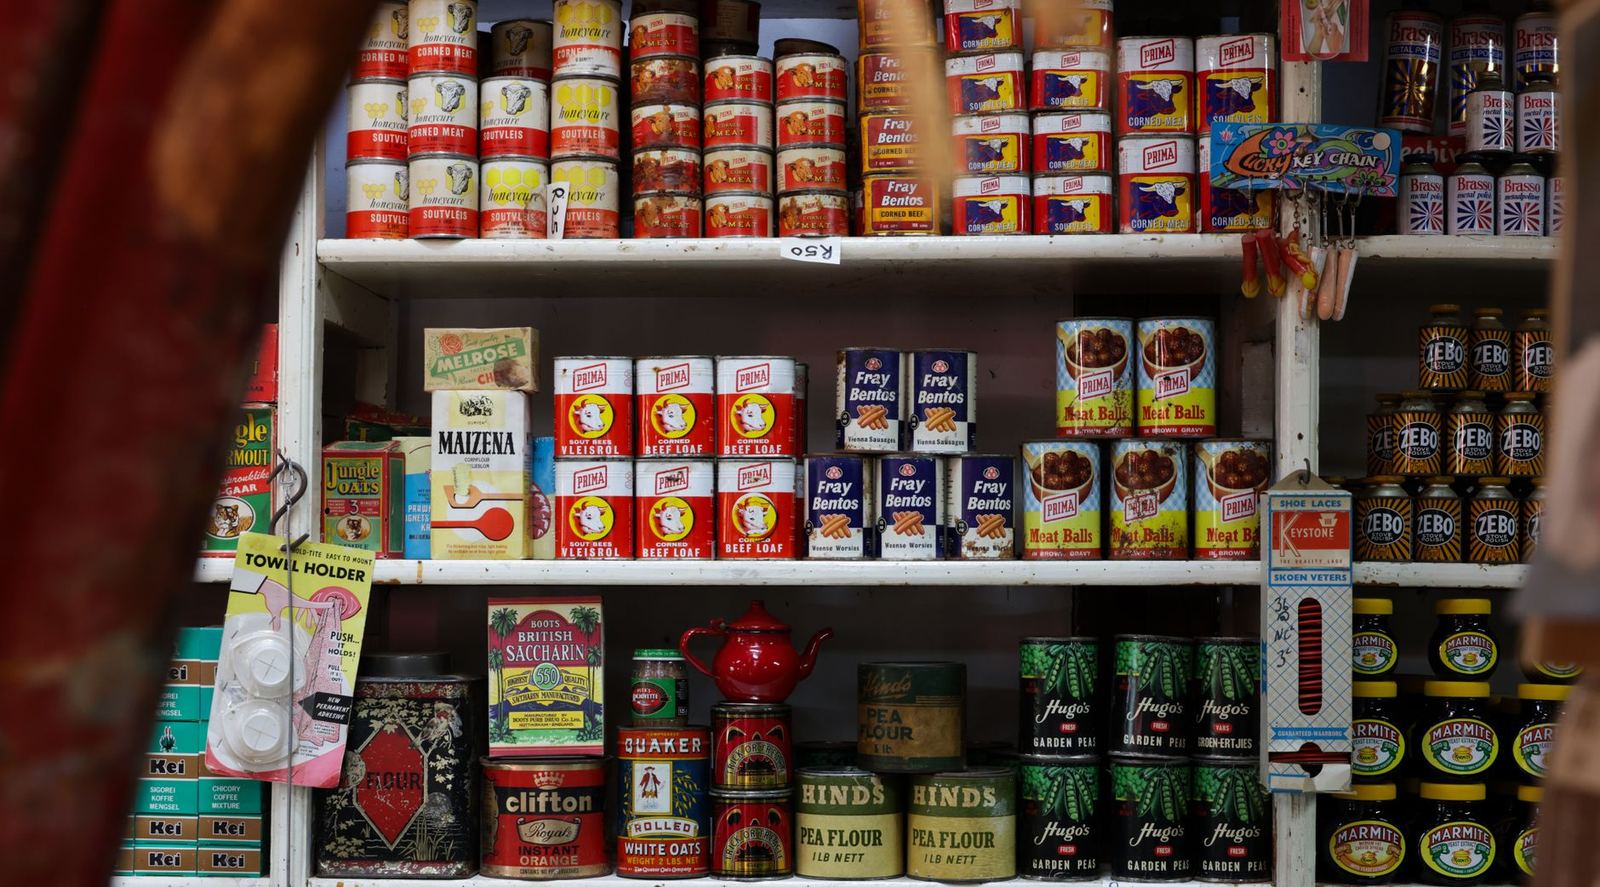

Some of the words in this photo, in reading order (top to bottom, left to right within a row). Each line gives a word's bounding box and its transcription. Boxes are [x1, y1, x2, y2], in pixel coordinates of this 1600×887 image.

[424, 32, 465, 44] honeycure
[560, 25, 611, 39] honeycure
[1451, 29, 1504, 47] Brasso
[418, 46, 450, 57] CORNED
[454, 47, 472, 59] MEAT
[1144, 45, 1172, 63] PRIMA
[983, 119, 999, 129] PRIMA
[410, 128, 438, 139] CORNED
[442, 127, 464, 138] MEAT
[483, 130, 523, 140] SOUTVLEIS
[1293, 151, 1323, 168] KEY
[1329, 152, 1378, 169] CHAIN
[983, 180, 999, 191] PRIMA
[1066, 179, 1081, 190] PRIMA
[1504, 179, 1541, 193] Brasso
[488, 189, 539, 202] honeycure
[423, 209, 467, 220] SOUTVLEIS
[791, 244, 832, 260] R50
[436, 342, 520, 374] MELROSE
[1426, 341, 1464, 363] ZEBO
[1474, 344, 1508, 366] ZEBO
[577, 370, 604, 387] PRIMA
[659, 369, 687, 387] PRIMA
[739, 369, 767, 387] PRIMA
[855, 371, 891, 388] Fray
[923, 374, 958, 390] Fray
[1082, 376, 1110, 394] PRIMA
[850, 388, 896, 401] Bentos
[918, 391, 964, 404] Bentos
[1098, 406, 1127, 421] Balls
[1142, 405, 1171, 421] Meat
[1174, 404, 1205, 420] Balls
[438, 431, 515, 455] MAIZENA
[869, 436, 896, 444] Sausages
[1400, 428, 1438, 451] ZEBO
[1503, 429, 1540, 452] ZEBO
[561, 445, 619, 455] VLEISROL
[645, 445, 673, 454] BEEF
[676, 444, 703, 454] LOAF
[724, 445, 751, 454] BEEF
[754, 445, 782, 454] LOAF
[326, 461, 380, 493] Jungle
[577, 473, 605, 490] PRIMA
[337, 480, 380, 497] OATS
[817, 481, 852, 496] Fray
[890, 477, 925, 493] Fray
[974, 481, 1007, 496] Fray
[349, 500, 359, 516] 3
[812, 497, 858, 510] Bentos
[885, 494, 931, 507] Bentos
[967, 497, 1011, 510] Bentos
[1047, 498, 1075, 517] PRIMA
[1280, 500, 1306, 508] SHOE
[1311, 500, 1342, 508] LACES
[1367, 513, 1402, 535] ZEBO
[1417, 515, 1451, 536] ZEBO
[1478, 514, 1515, 536] ZEBO
[1030, 528, 1058, 544] Meat
[1063, 528, 1093, 543] Balls
[1207, 528, 1238, 543] Meat
[561, 547, 620, 557] VLEISROL
[642, 548, 670, 557] BEEF
[673, 547, 700, 557] LOAF
[725, 543, 753, 552] BEEF
[756, 543, 783, 552] LOAF
[326, 552, 340, 562] EASY
[343, 555, 351, 563] TO
[352, 556, 373, 568] MOUNT
[303, 561, 367, 583] HOLDER
[1274, 573, 1308, 582] SKOEN
[1310, 573, 1347, 582] VETERS
[531, 620, 560, 629] BOOTS
[518, 631, 573, 643] BRITISH
[1447, 635, 1492, 650] MARMITE
[328, 648, 356, 658] HOLDS!
[505, 645, 585, 662] SACCHARIN
[537, 667, 559, 685] 550
[564, 675, 586, 687] QUALITY
[315, 702, 350, 713] PERMANENT
[327, 696, 341, 704] NEW
[317, 711, 346, 721] ADHESIVE
[866, 708, 902, 725] PEA
[1035, 699, 1090, 724] Hugo's
[1126, 697, 1183, 721] Hugo's
[1195, 699, 1250, 723] Hugo's
[1432, 722, 1492, 743] MARMITE
[624, 737, 701, 754] QUAKER
[1033, 737, 1072, 748] GARDEN
[1077, 737, 1096, 748] PEAS
[1123, 734, 1162, 747] GARDEN
[149, 758, 185, 775] Kei
[367, 771, 421, 790] FLOUR
[150, 785, 176, 794] SIGOREI
[211, 785, 241, 793] CHICORY
[801, 784, 885, 805] HINDS
[913, 785, 996, 807] HINDS
[151, 794, 174, 803] KOFFIE
[211, 802, 240, 810] MIXTURE
[505, 791, 592, 813] clifton
[149, 802, 180, 811] MENGSEL
[150, 821, 182, 836] Kei
[213, 820, 246, 837] Kei
[635, 822, 691, 834] ROLLED
[1034, 822, 1090, 846] Hugo's
[1129, 823, 1184, 847] Hugo's
[1203, 823, 1261, 847] Hugo's
[801, 826, 824, 846] PEA
[827, 829, 882, 846] FLOUR
[912, 828, 935, 848] PEA
[939, 831, 995, 848] FLOUR
[1337, 827, 1400, 846] MARMITE
[1431, 827, 1490, 845] MARMITE
[518, 845, 579, 856] INSTANT
[624, 842, 667, 857] WHITE
[669, 841, 701, 857] OATS
[727, 837, 742, 862] TRICK
[149, 853, 181, 868] Kei
[212, 853, 245, 869] Kei
[520, 855, 578, 866] ORANGE
[627, 856, 655, 866] WEIGHT
[686, 856, 700, 865] NET
[818, 852, 830, 862] LB
[834, 853, 864, 863] NETT
[946, 855, 976, 865] NETT
[1032, 859, 1070, 870] GARDEN
[1077, 859, 1096, 870] PEAS
[1127, 860, 1166, 871] GARDEN
[1202, 860, 1240, 871] GARDEN
